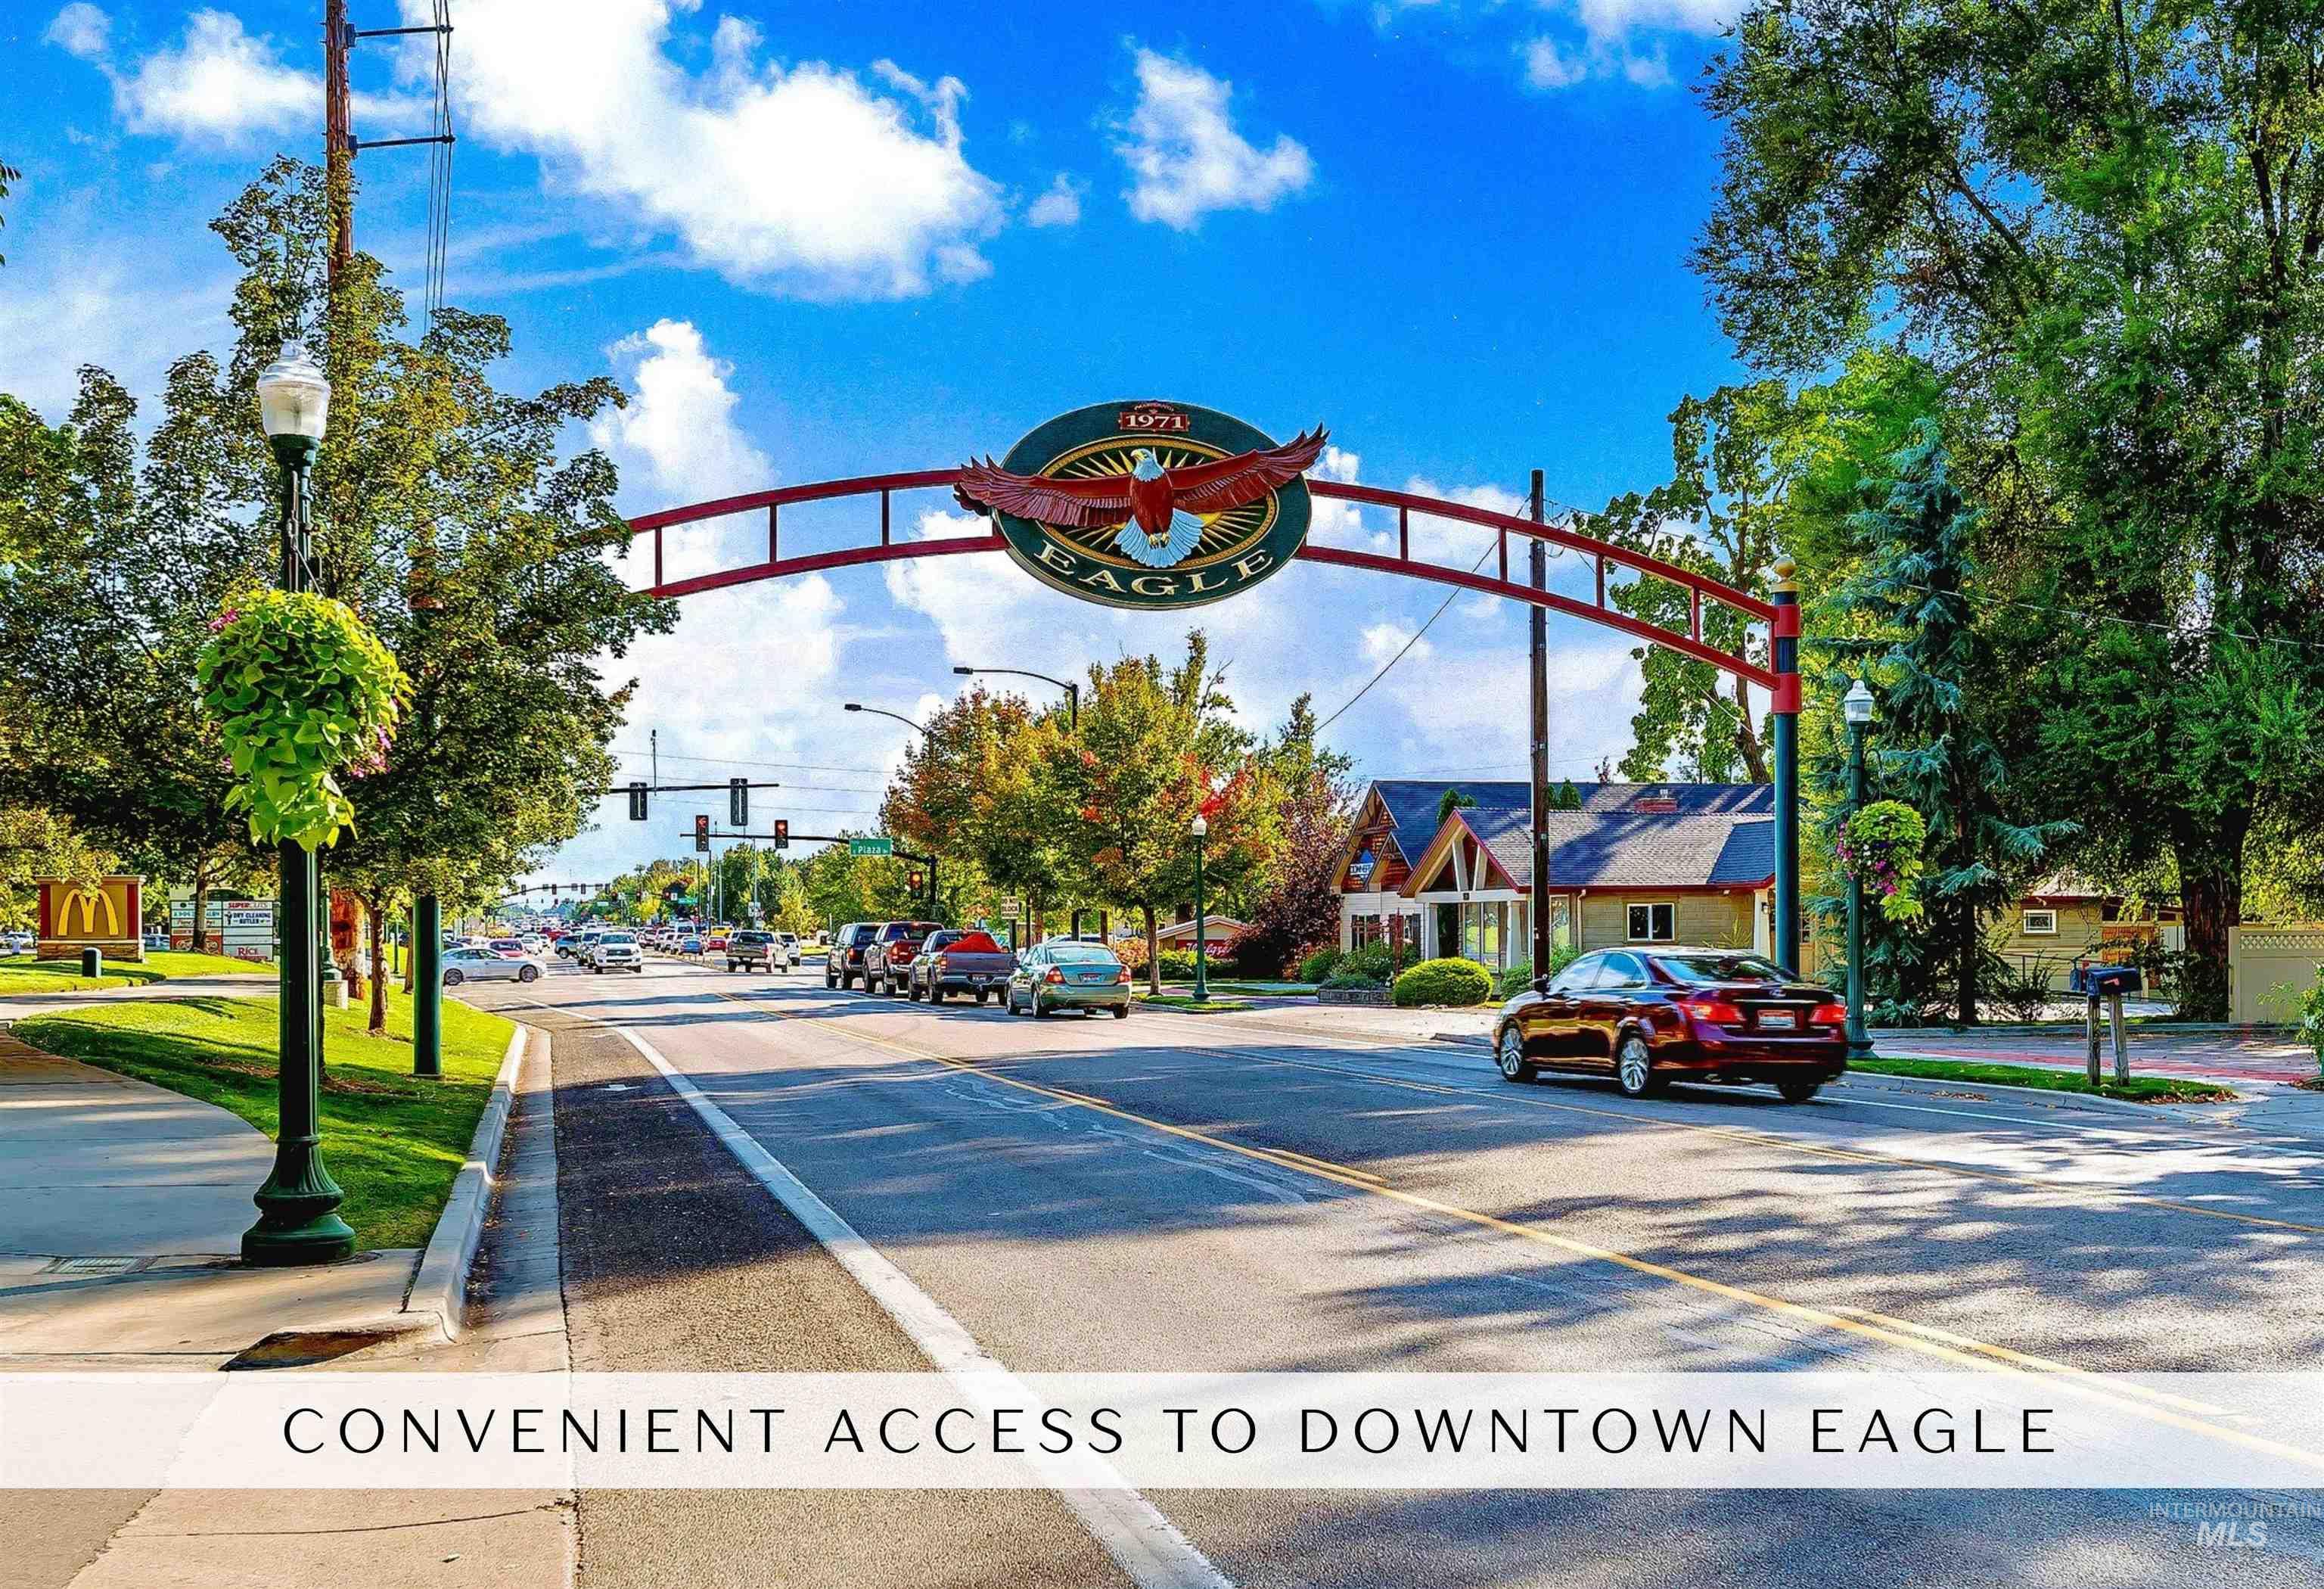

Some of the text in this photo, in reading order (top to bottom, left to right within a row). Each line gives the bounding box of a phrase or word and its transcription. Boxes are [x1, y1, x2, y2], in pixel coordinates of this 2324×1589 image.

[1125, 414, 1185, 429] 1971
[1033, 539, 1274, 596] EAGLE
[858, 845, 881, 854] Plaza
